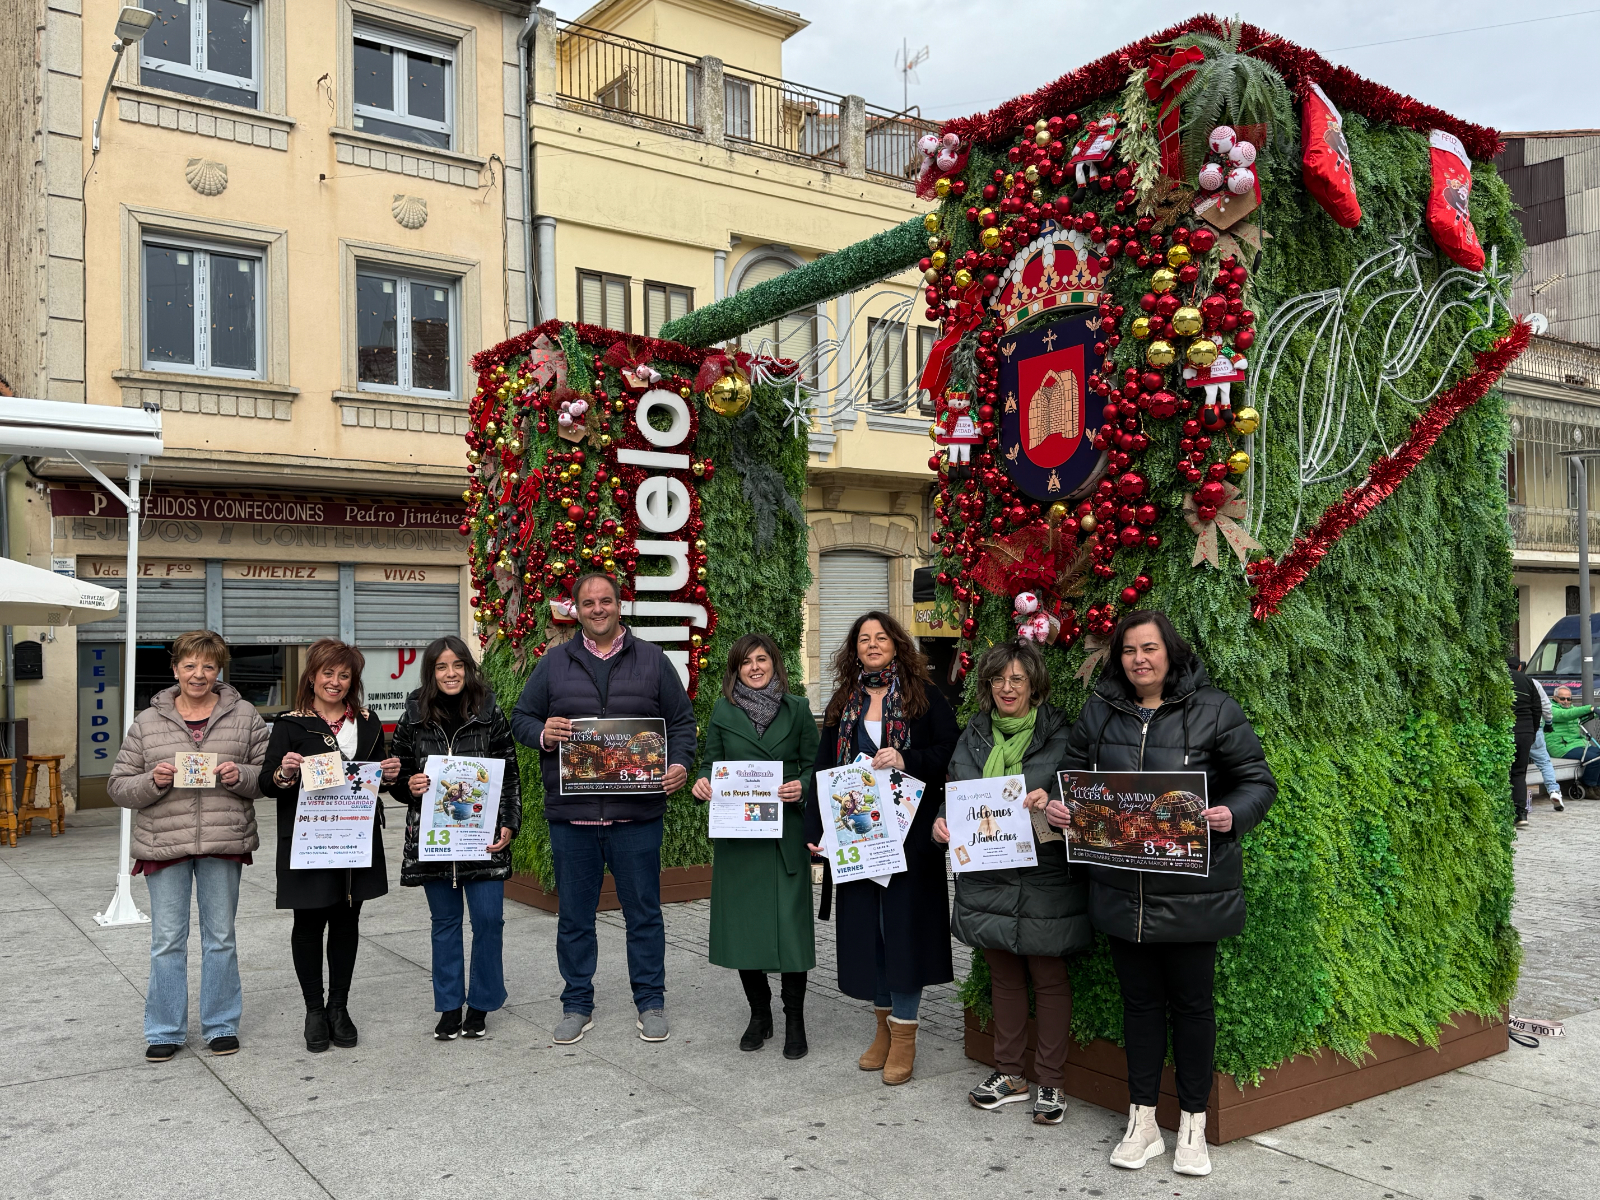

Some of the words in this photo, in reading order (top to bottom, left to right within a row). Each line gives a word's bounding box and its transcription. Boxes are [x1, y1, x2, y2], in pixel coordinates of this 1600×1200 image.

[139, 497, 197, 516] TEJIDOS
[200, 499, 211, 517] Y
[214, 500, 324, 522] CONFECCIONES
[344, 504, 394, 523] Pedro
[617, 388, 708, 692] ijuelo
[92, 562, 119, 576] Vda
[138, 564, 155, 576] E
[240, 564, 317, 578] JIMENEZ
[384, 568, 426, 581] VIVAS
[91, 649, 110, 759] TEJIDOS
[368, 692, 403, 700] SUMINISTROS
[1074, 790, 1100, 800] LUCES
[1104, 793, 1114, 801] de
[1117, 793, 1155, 802] NAVIDAD
[966, 805, 1013, 821] Adornos
[426, 830, 451, 845] 13
[968, 830, 1018, 846] Navideños
[836, 846, 860, 866] 13
[1144, 840, 1159, 856] 3,
[1166, 842, 1181, 857] 2,
[837, 864, 864, 874] VIERNES
[1532, 1024, 1555, 1035] LOLA
